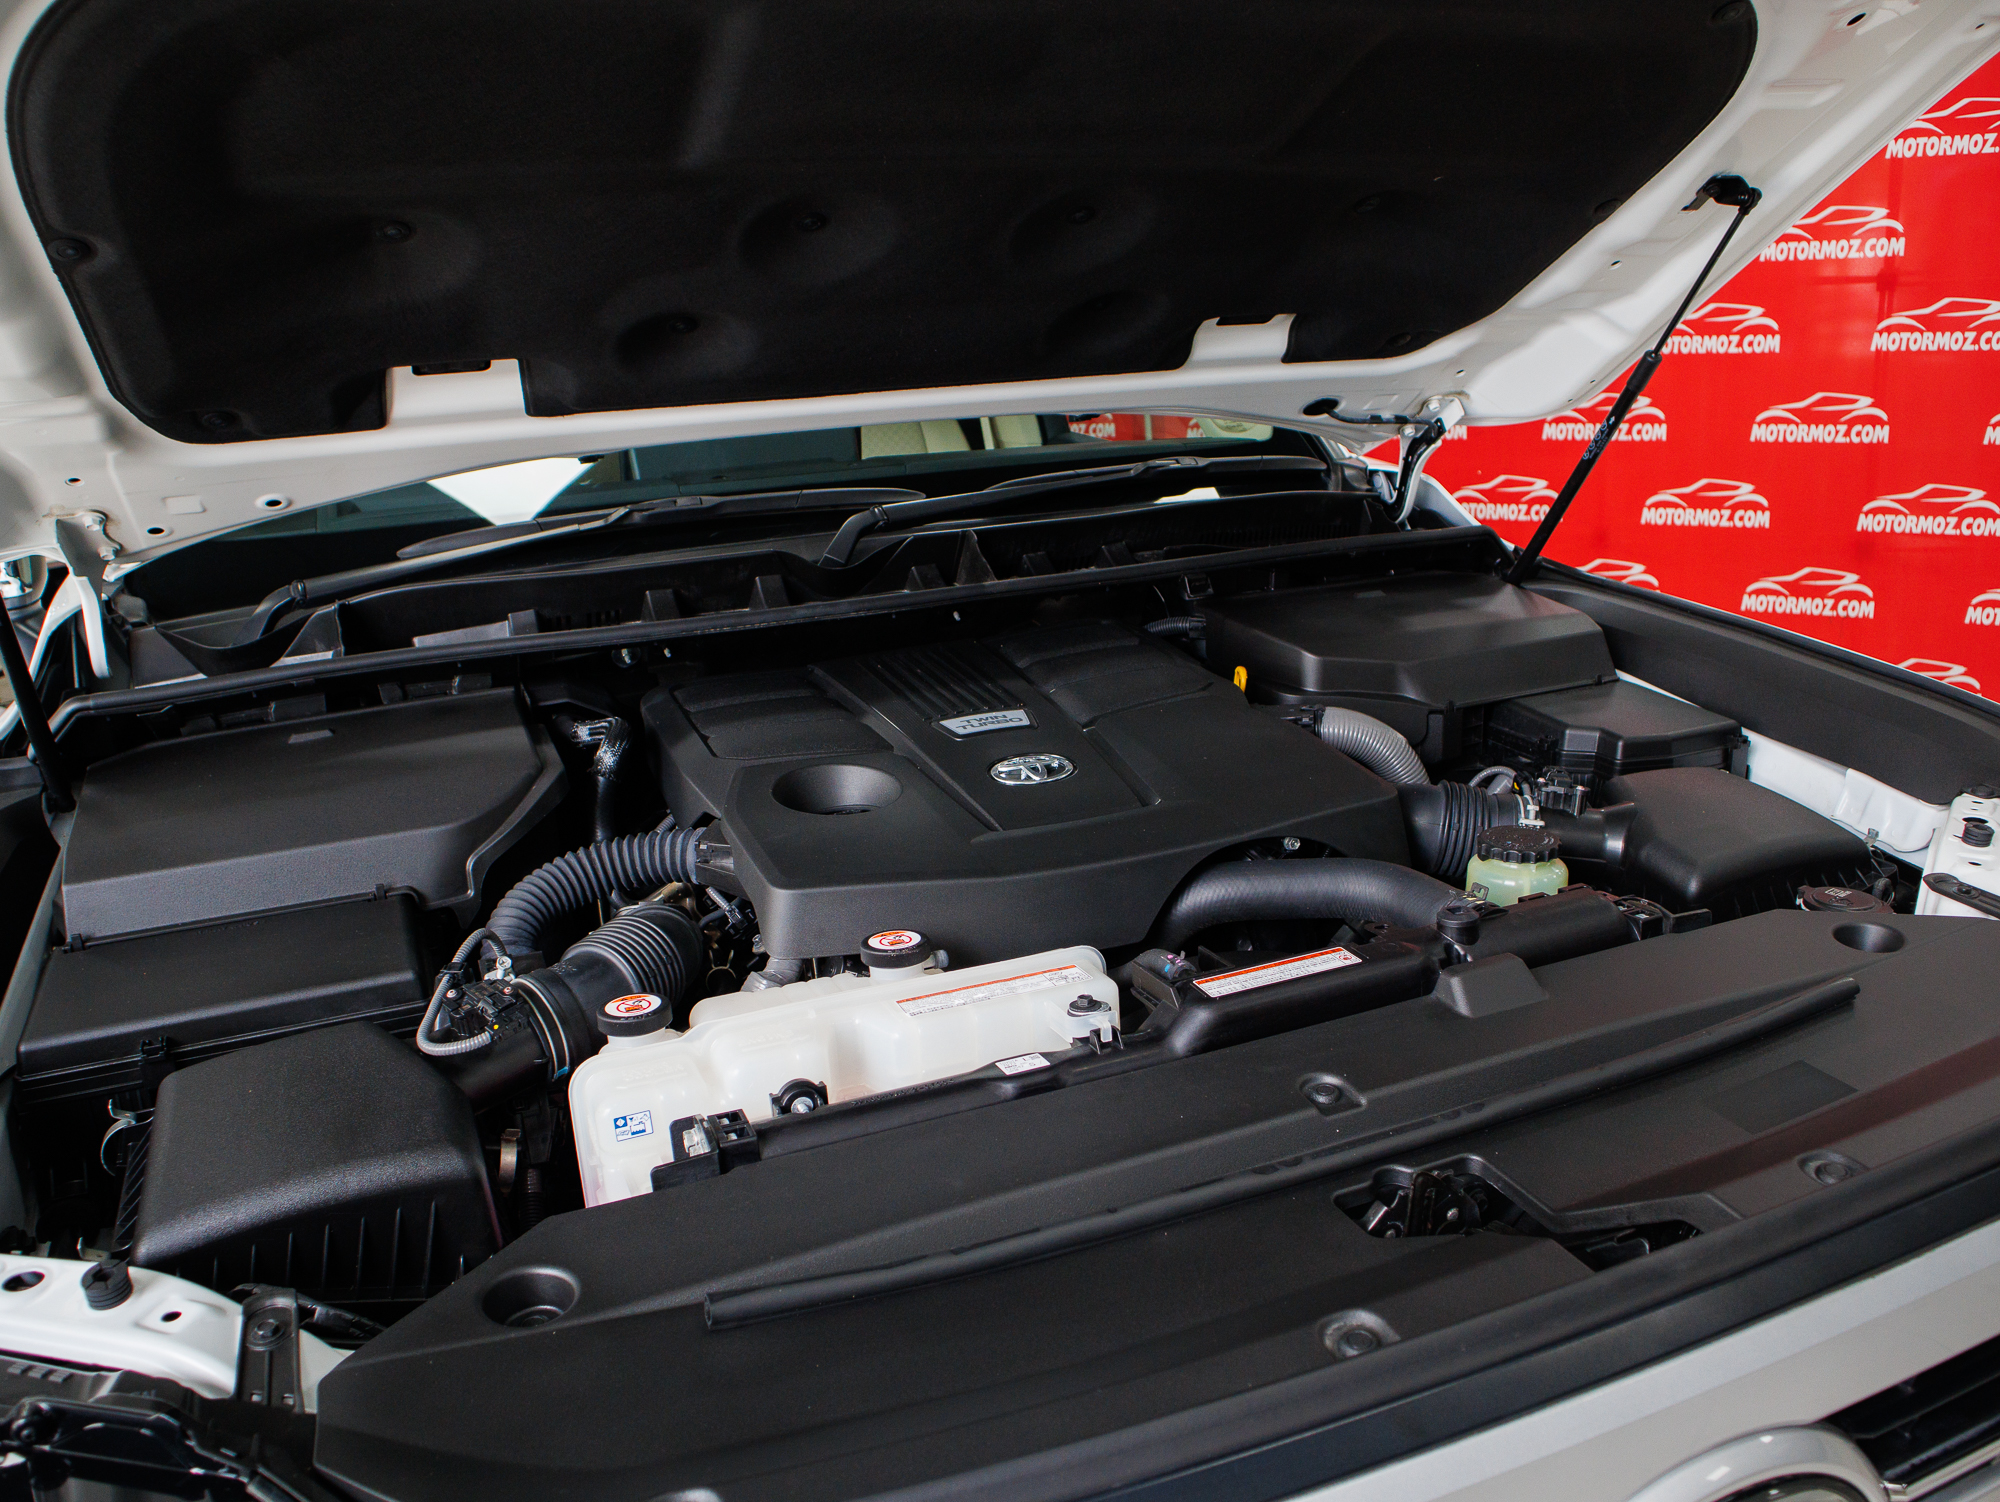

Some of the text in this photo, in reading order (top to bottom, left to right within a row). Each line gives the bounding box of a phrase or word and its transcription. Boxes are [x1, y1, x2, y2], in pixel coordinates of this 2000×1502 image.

[1759, 236, 1906, 262] MOTORMOZ.COM
[1661, 333, 1781, 355] OTORMOZ.COM
[1749, 423, 1890, 444] MOTORMOZ.COM
[1641, 506, 1770, 529] MOTORMOZ.COM
[1856, 512, 2000, 537] MOTORMOZ.COM
[1740, 593, 1875, 619] MOTORMOZ.COM
[956, 717, 1024, 730] TURBO
[960, 714, 1008, 724] TWIN
